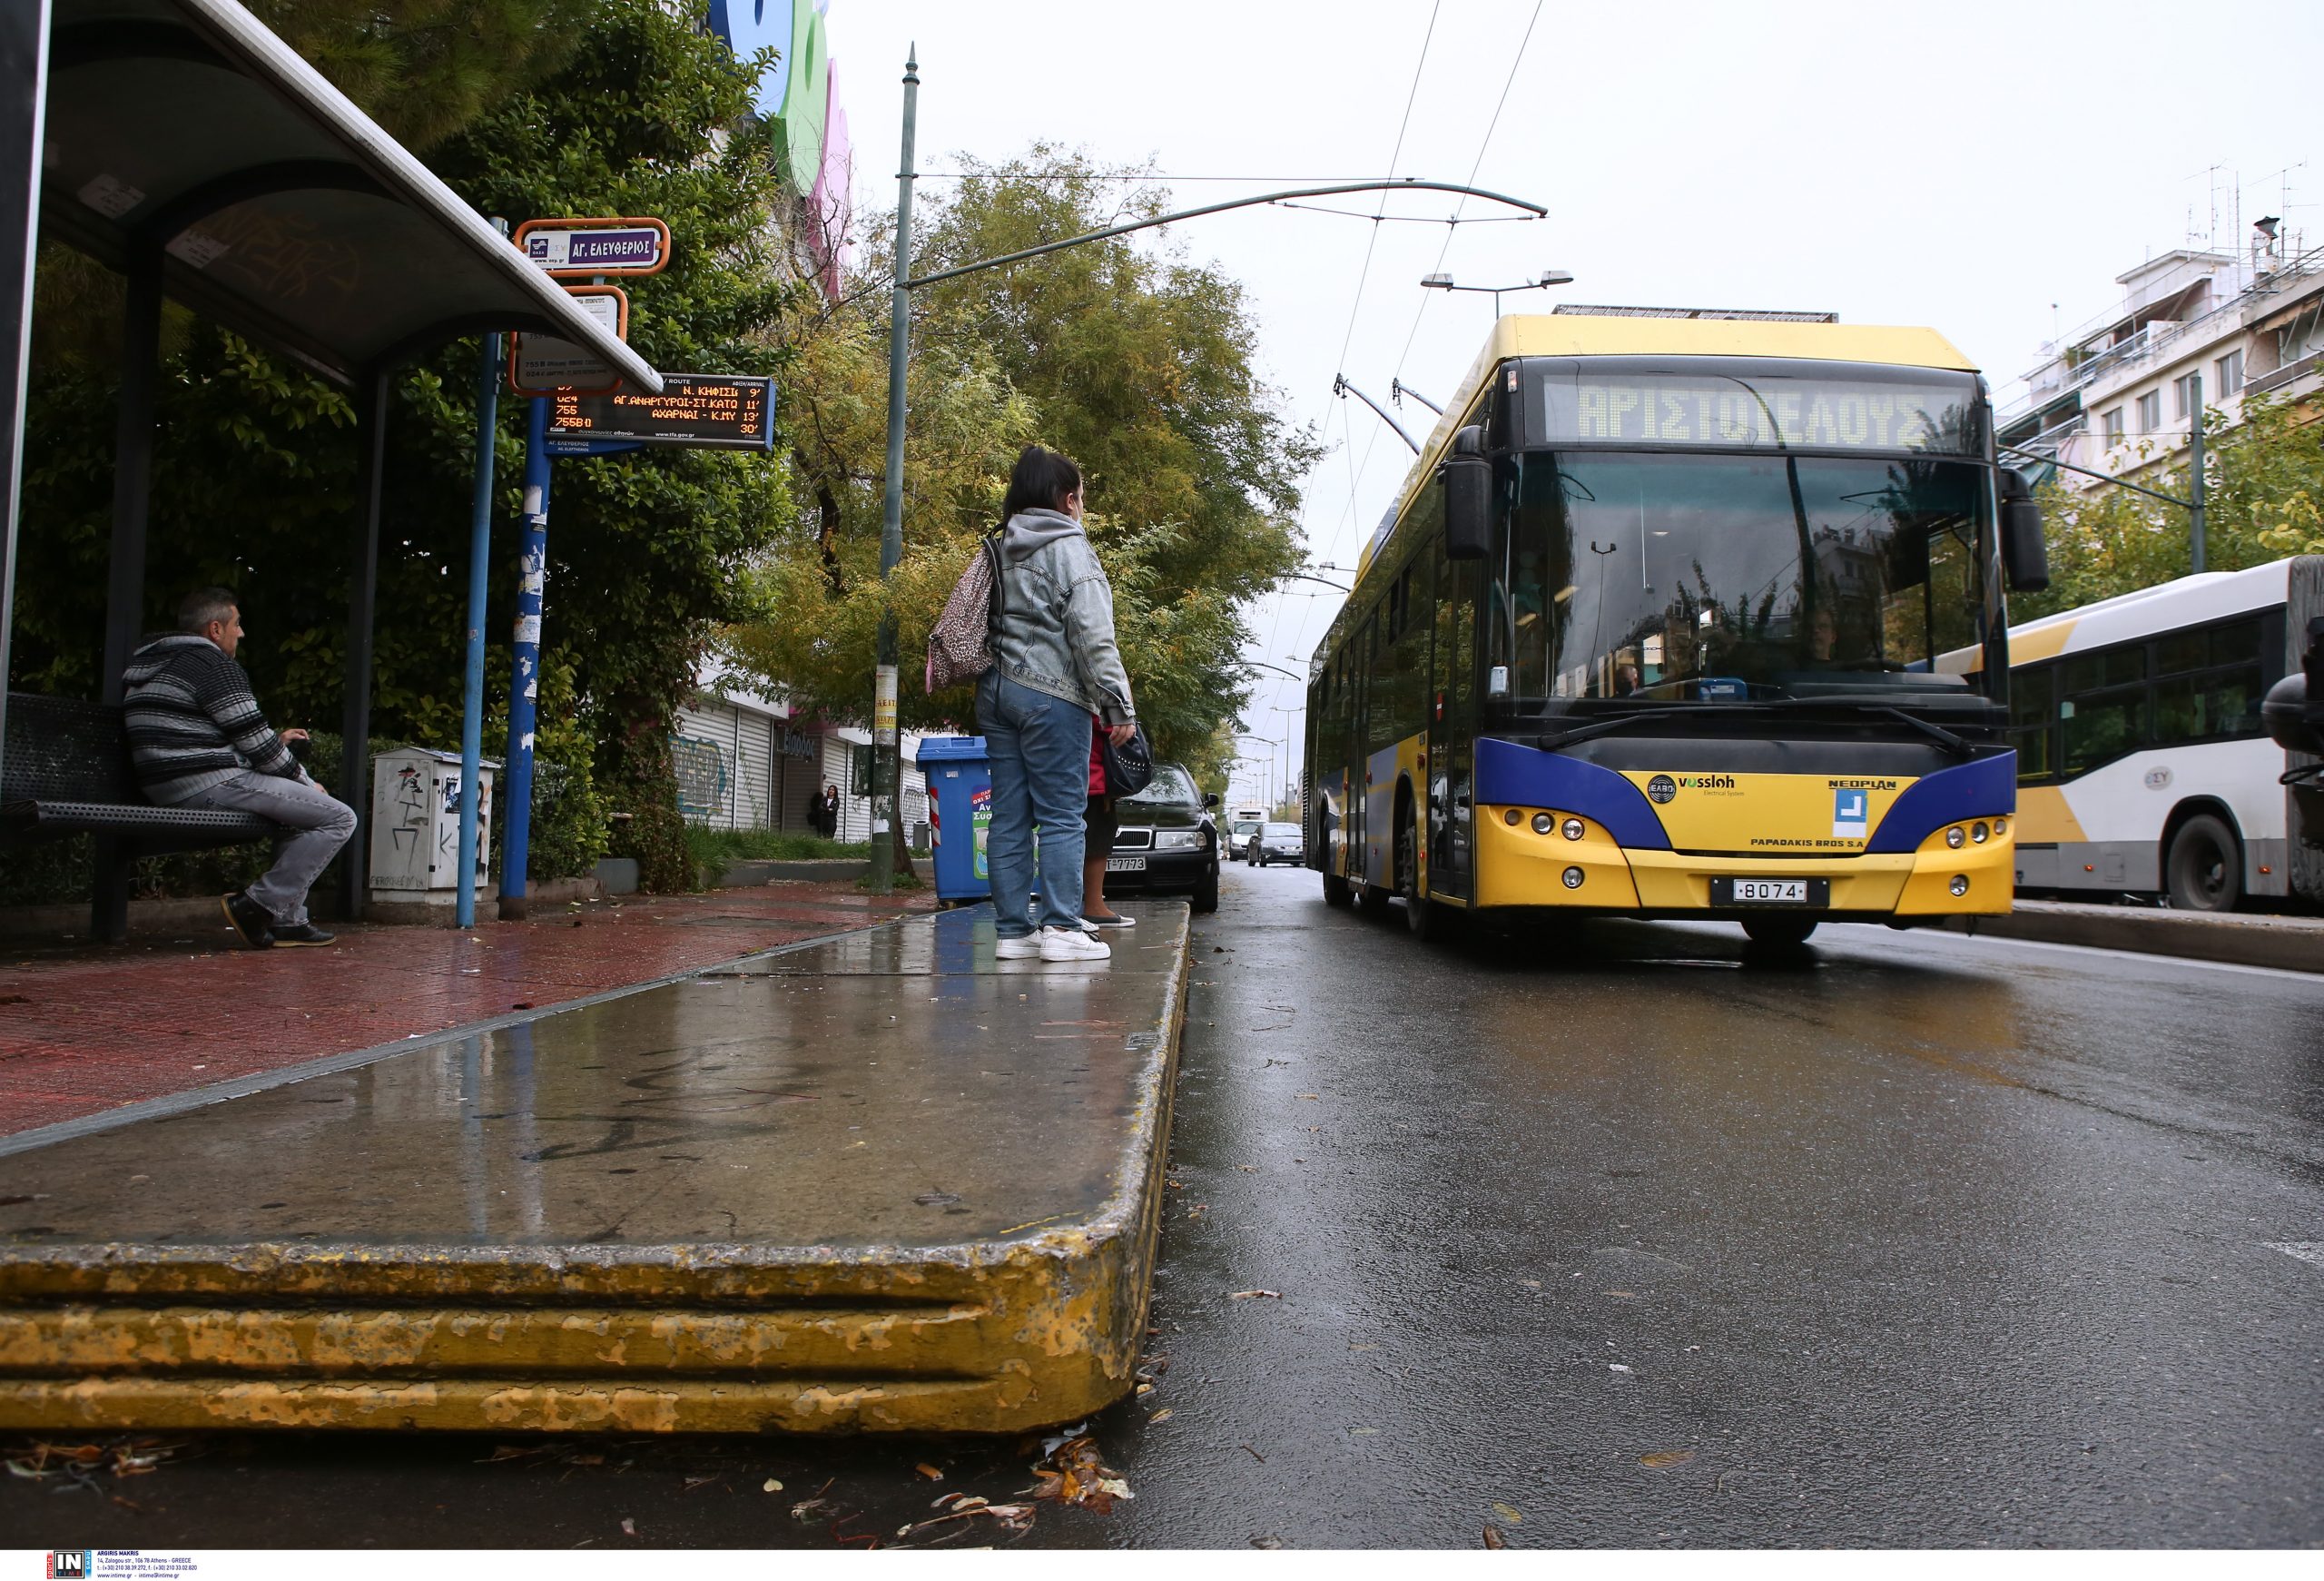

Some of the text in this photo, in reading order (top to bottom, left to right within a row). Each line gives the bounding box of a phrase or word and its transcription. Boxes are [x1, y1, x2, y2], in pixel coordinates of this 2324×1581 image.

[572, 241, 650, 257] ΑΓ. ΕΛΕΥΘΕΡΙΟΣ
[556, 405, 577, 415] 755
[652, 409, 698, 419] ΑΧΑΡΝΑΙ
[1577, 385, 1928, 447] ΑΡΙΣΤΟΤΕΛΟΥΣ
[1679, 774, 1734, 788] vossloh
[1828, 780, 1896, 790] NEOPLAN
[1745, 884, 1796, 898] 8074
